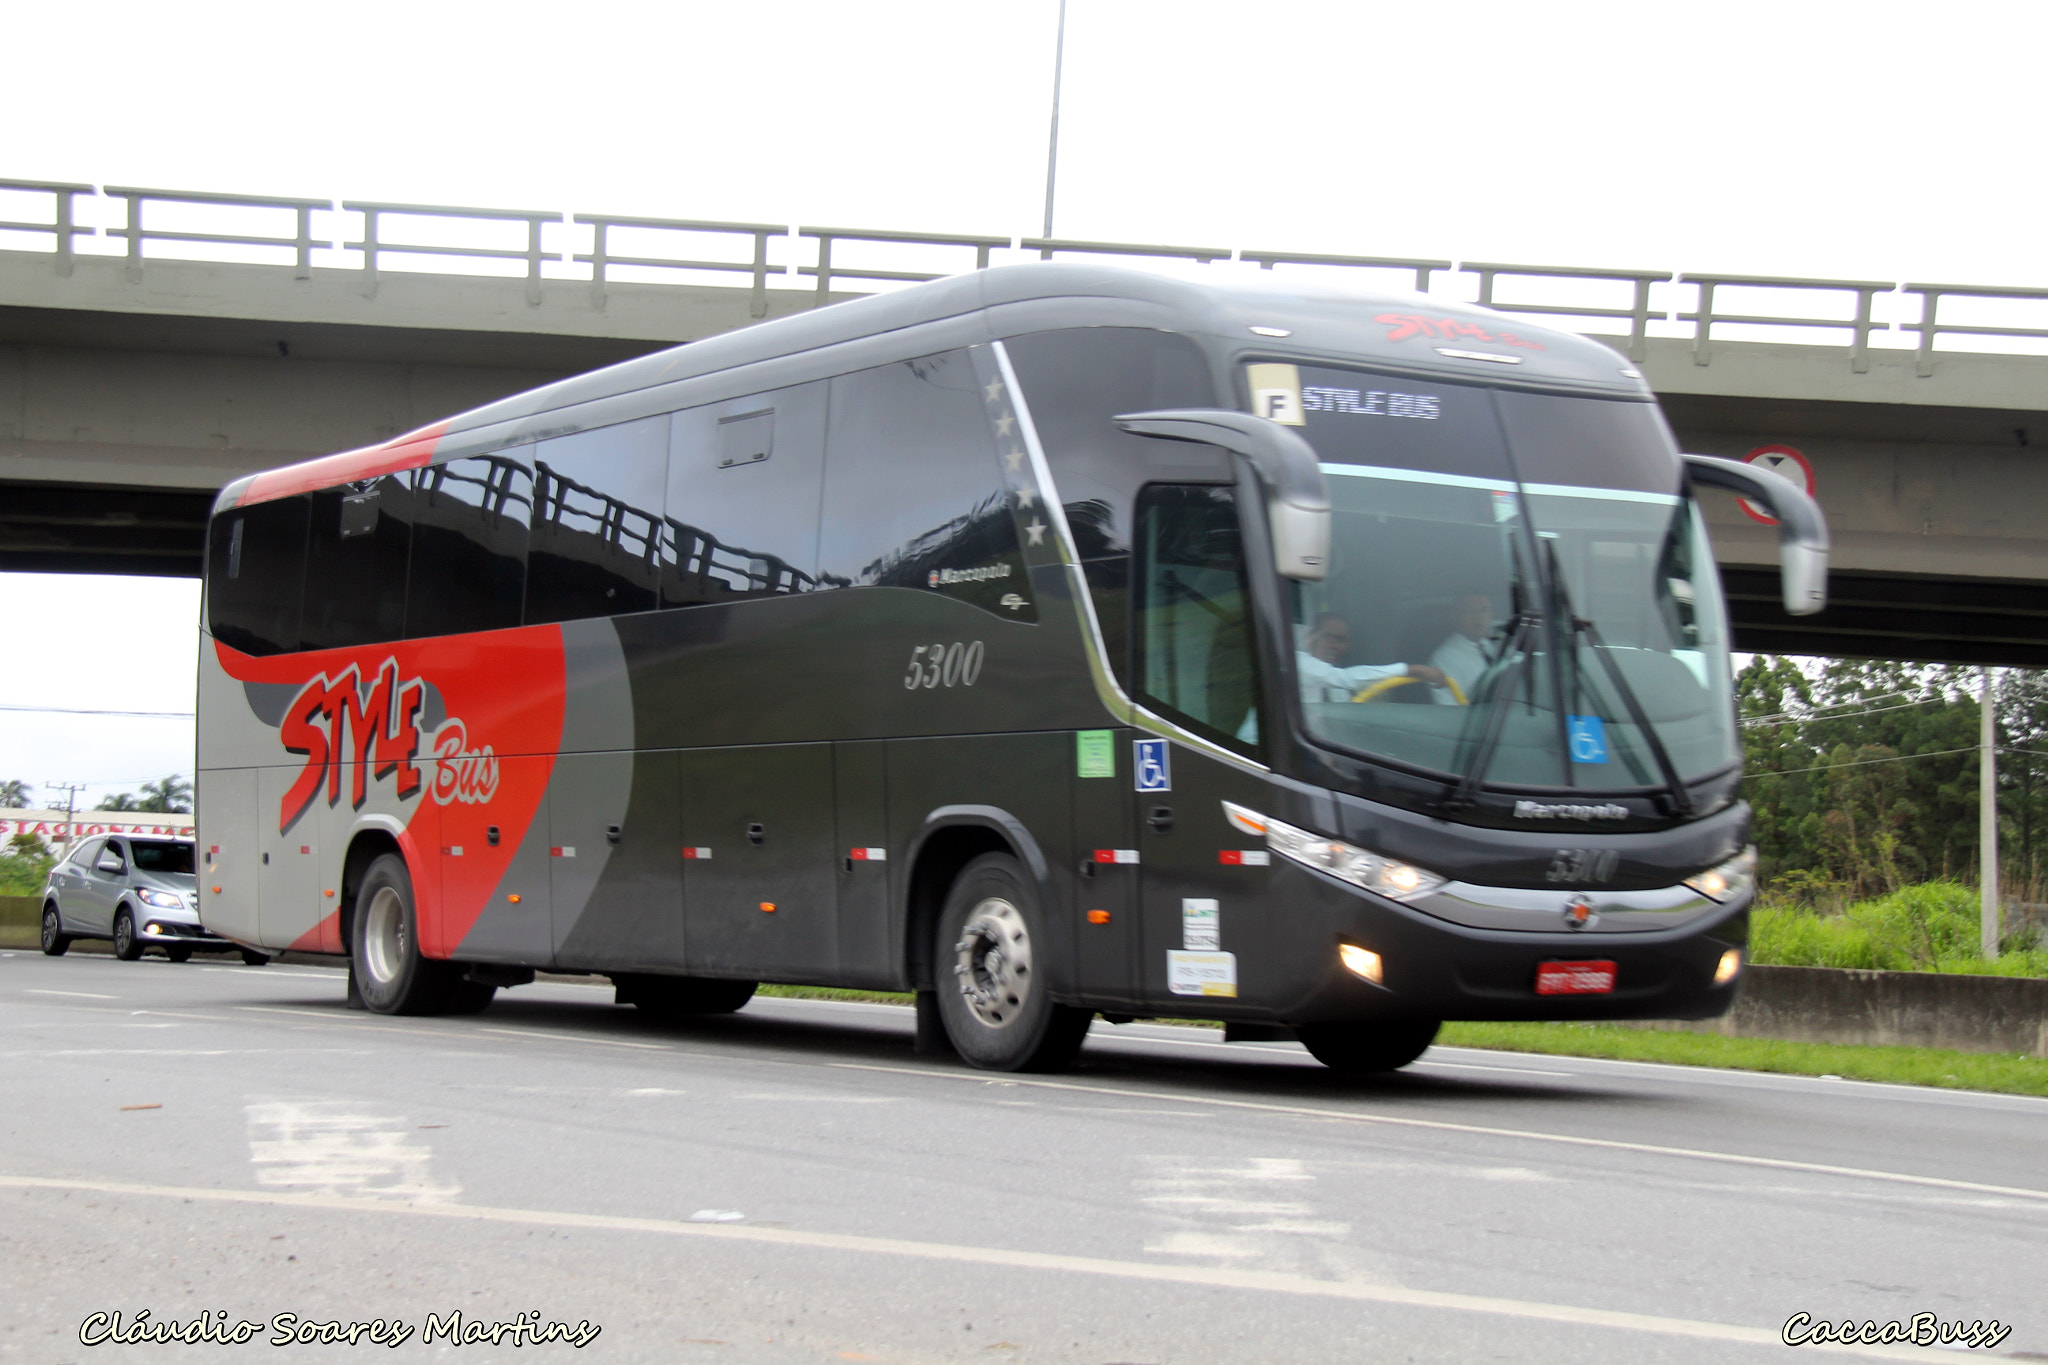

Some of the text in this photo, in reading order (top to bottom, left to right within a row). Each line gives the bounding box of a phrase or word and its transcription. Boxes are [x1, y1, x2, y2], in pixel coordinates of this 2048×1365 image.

[1268, 395, 1286, 418] F
[904, 640, 985, 690] 5300
[280, 655, 499, 837] STYLE Bus
